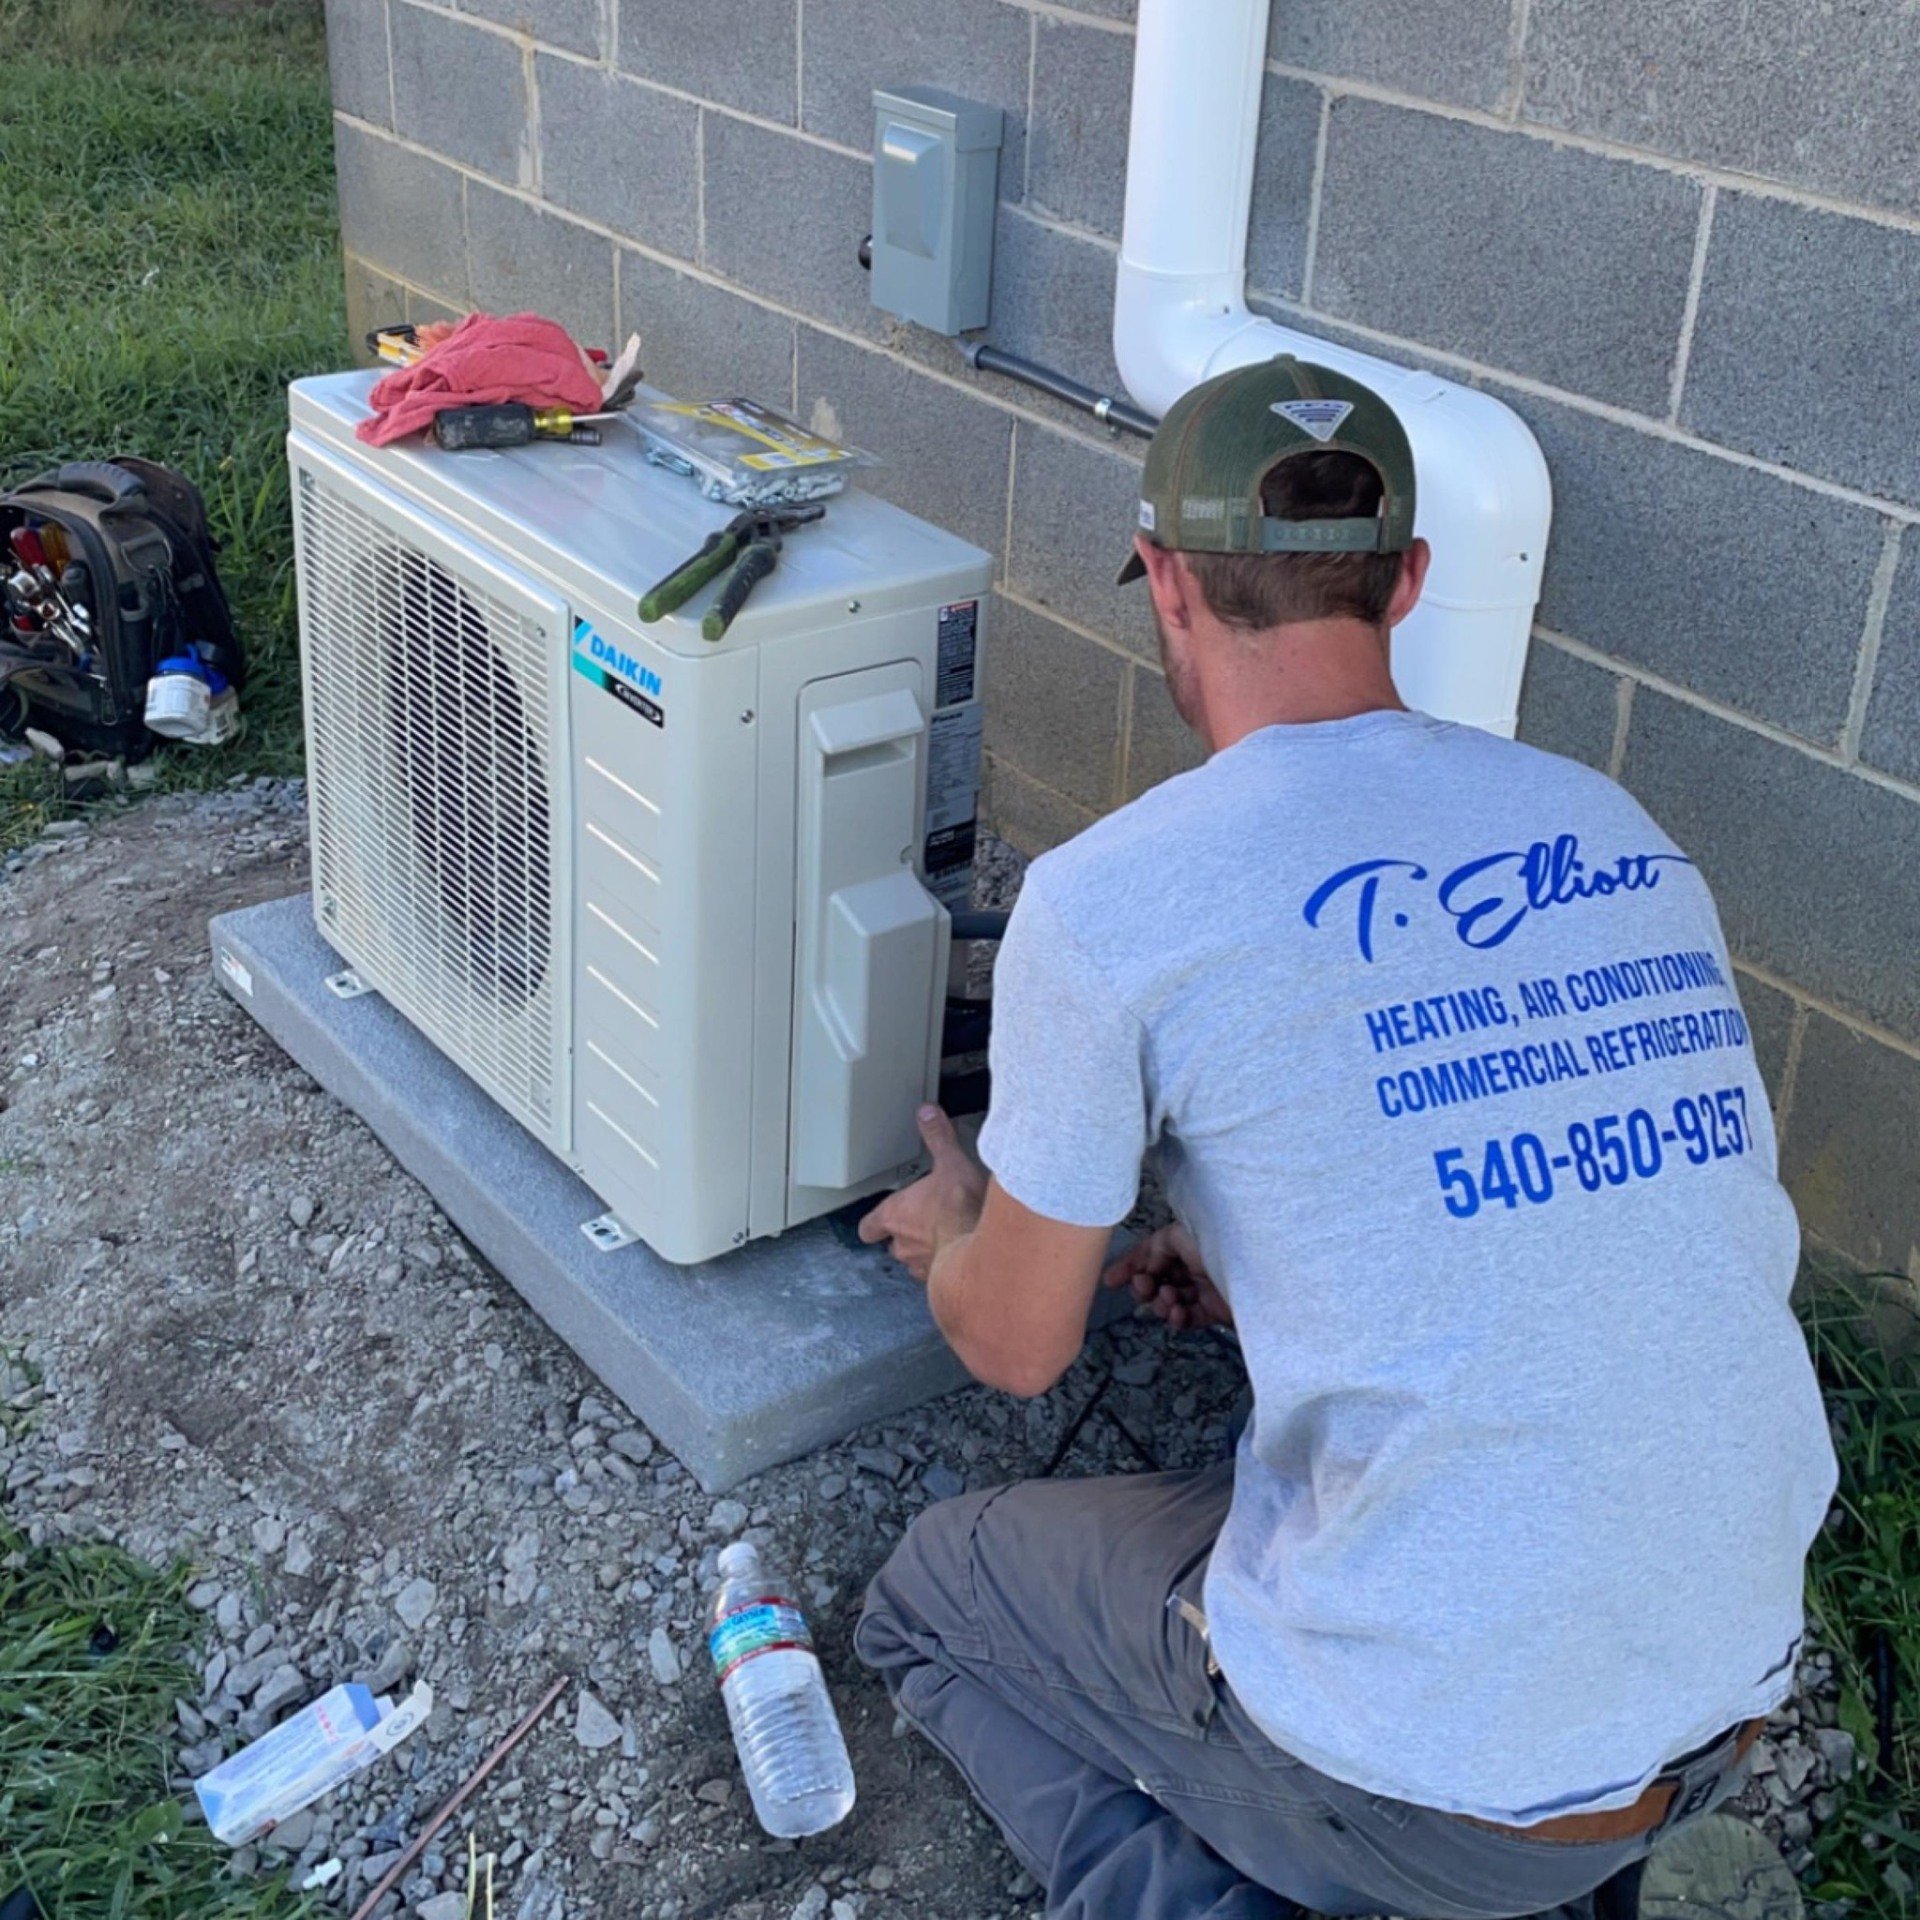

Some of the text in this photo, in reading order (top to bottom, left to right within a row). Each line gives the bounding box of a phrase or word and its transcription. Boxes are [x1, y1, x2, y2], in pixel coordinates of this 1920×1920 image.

[590, 633, 662, 696] DAIKIN
[1302, 833, 1692, 963] T. Elliott
[1365, 985, 1519, 1052] HEATING,
[1517, 970, 1567, 1020] AIR
[1376, 1038, 1589, 1118] COMMERCIAL
[1433, 1086, 1754, 1219] 540-850-9257
